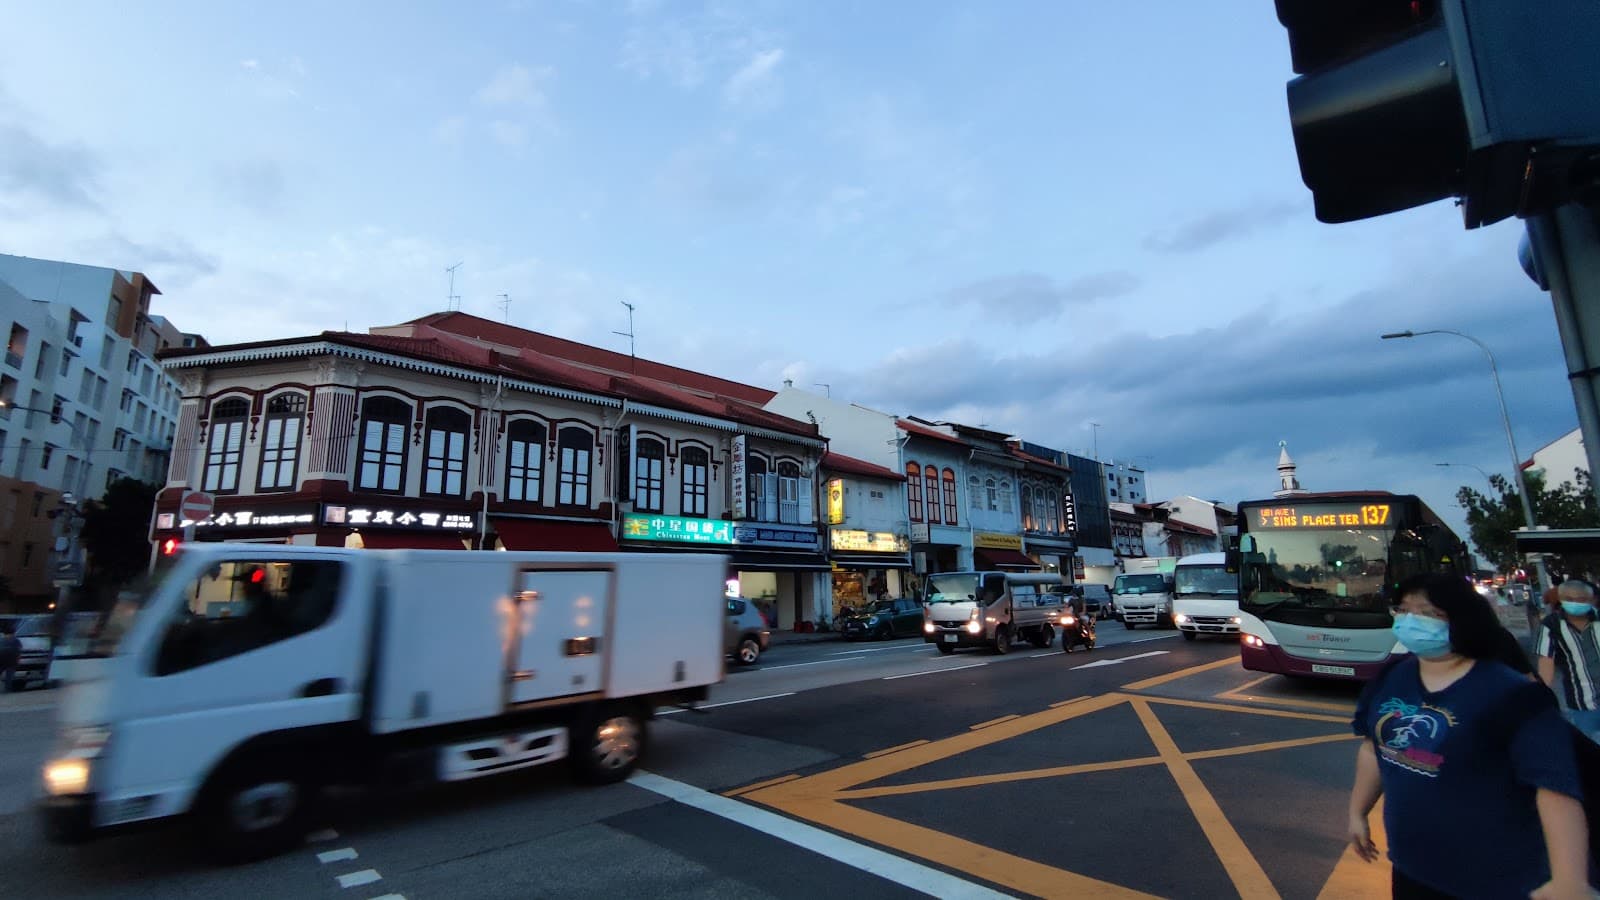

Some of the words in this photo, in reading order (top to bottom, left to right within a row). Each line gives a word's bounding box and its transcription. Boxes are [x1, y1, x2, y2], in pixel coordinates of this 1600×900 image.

[1274, 508, 1290, 517] AVE
[1361, 504, 1390, 525] 137
[1273, 516, 1298, 526] SIMS
[1302, 515, 1337, 526] PLACE
[1340, 514, 1360, 525] TER
